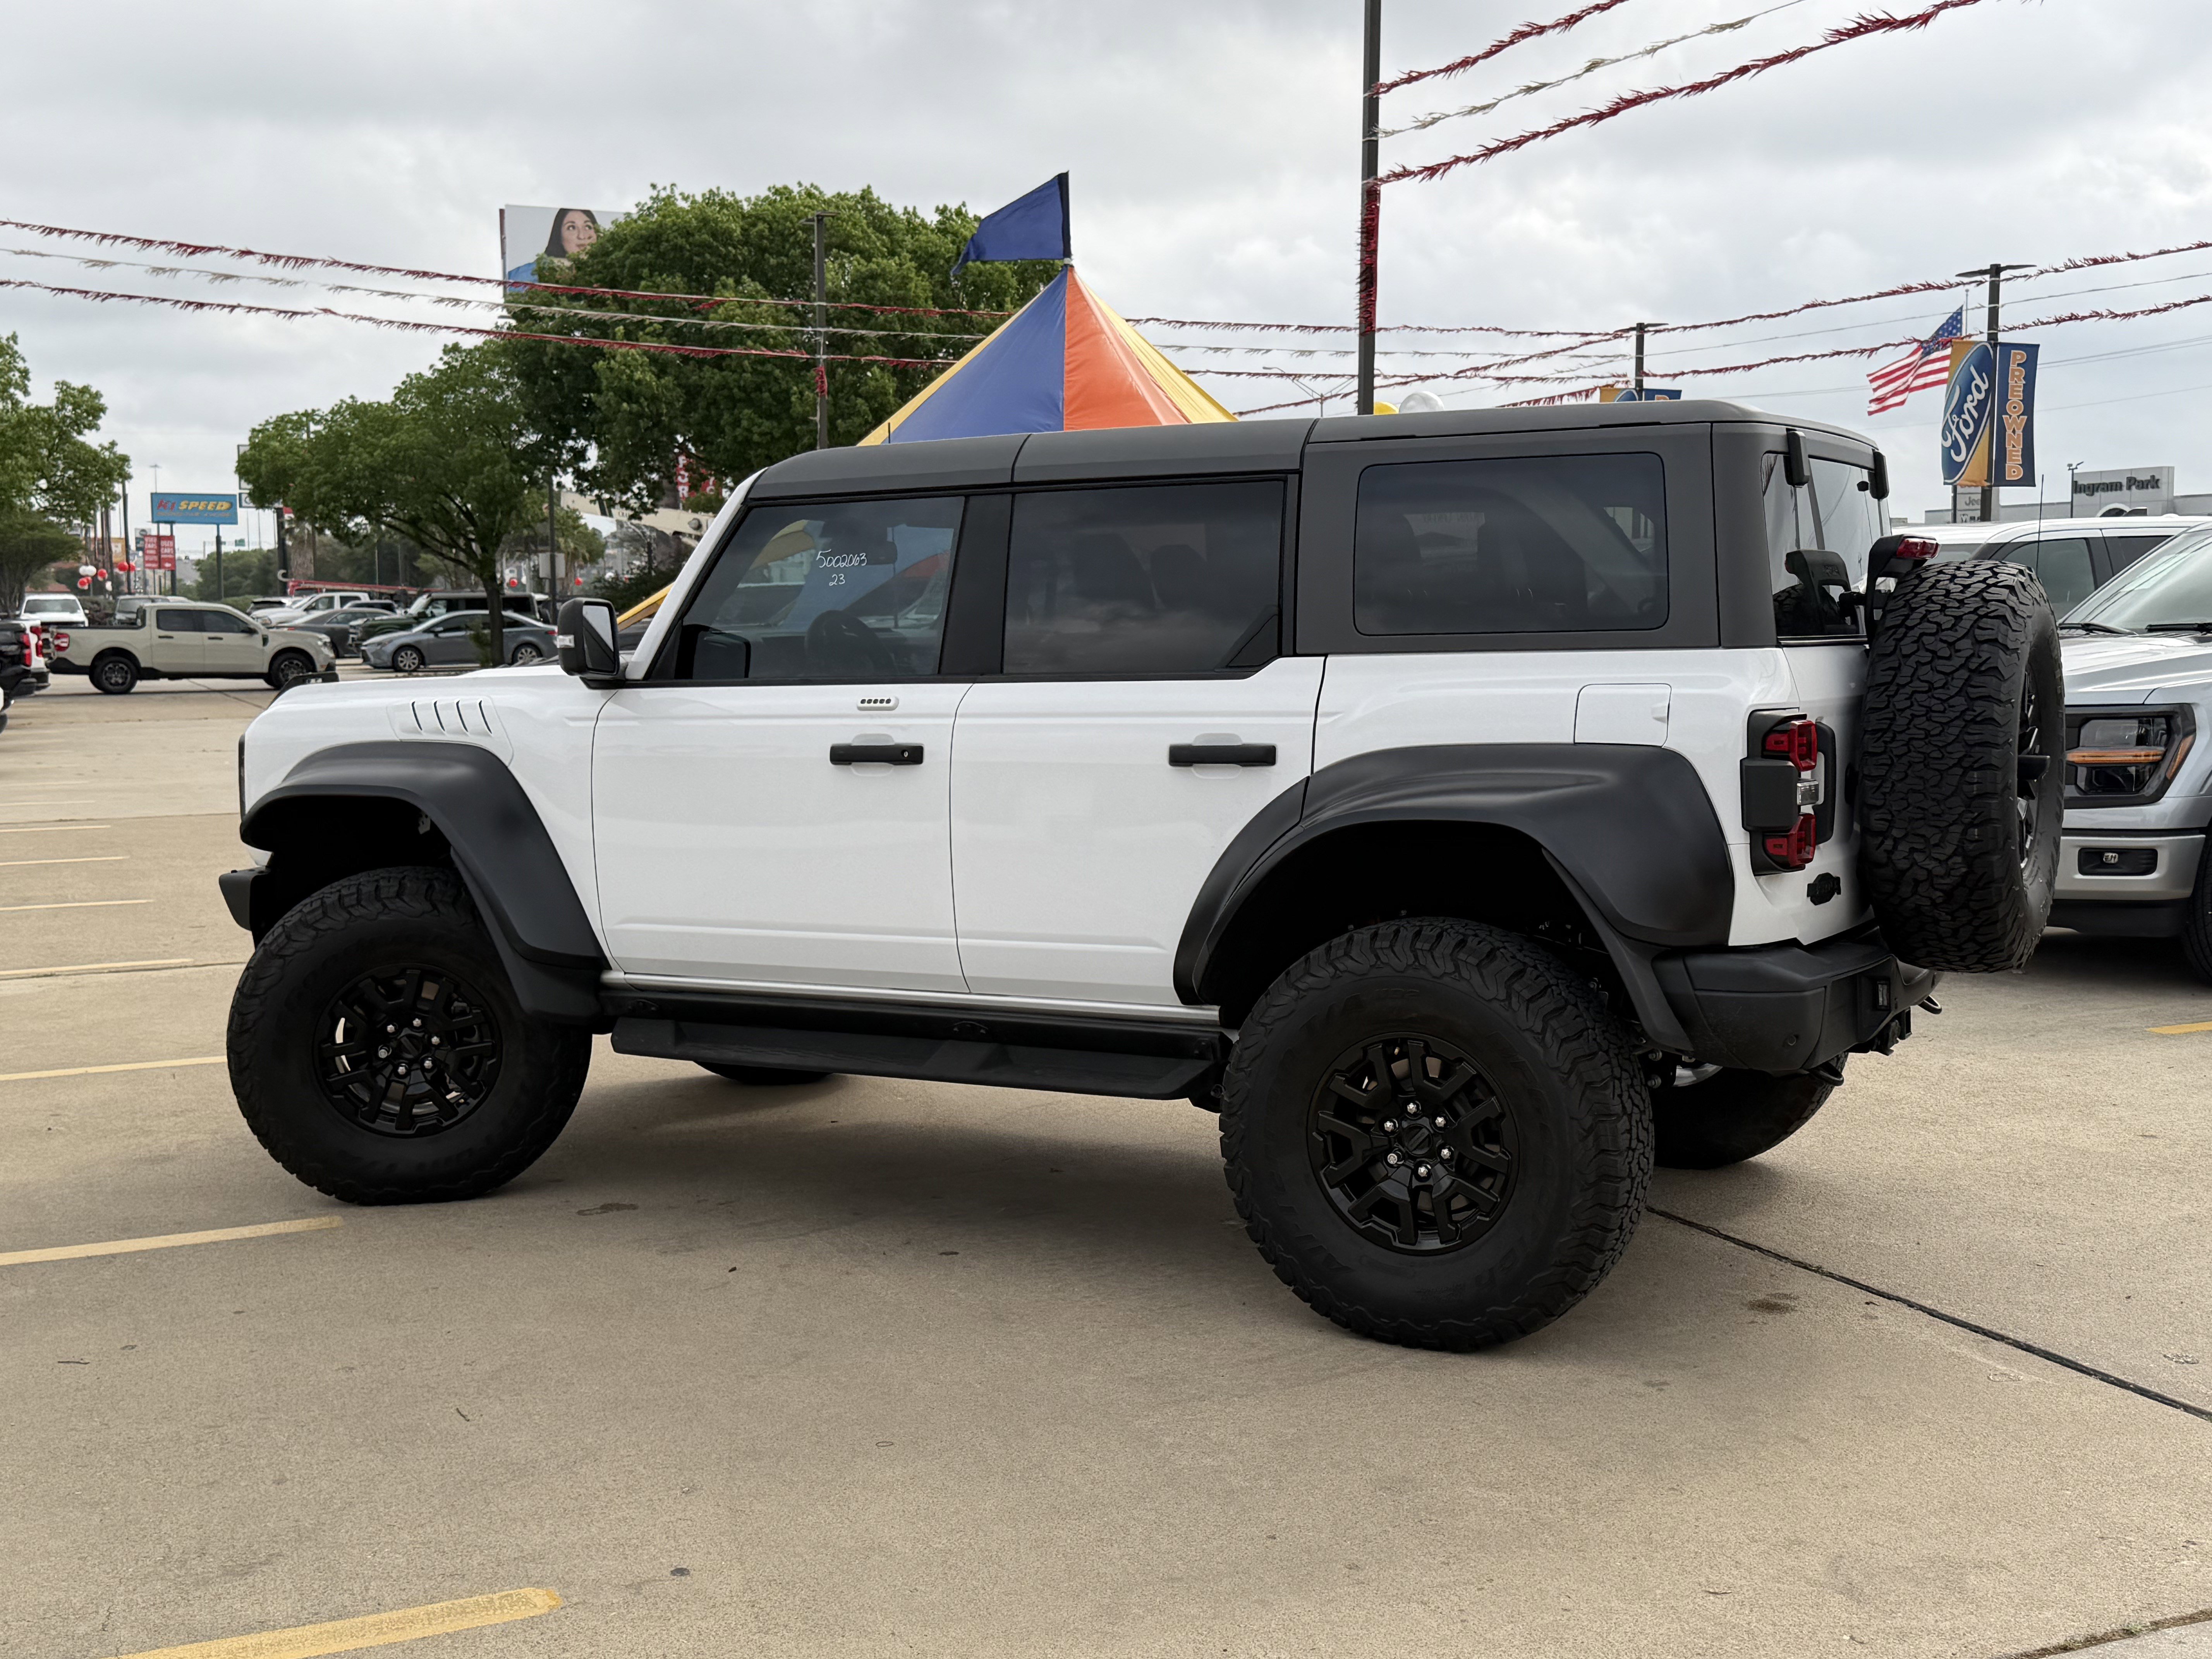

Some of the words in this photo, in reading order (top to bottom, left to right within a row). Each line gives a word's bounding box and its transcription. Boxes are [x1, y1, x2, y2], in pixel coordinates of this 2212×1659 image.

[1941, 364, 1989, 462] Ford
[2002, 350, 2027, 480] PREOWNED
[2073, 480, 2123, 496] Ingram
[2126, 475, 2160, 490] Park
[179, 500, 232, 511] SPEED
[1965, 496, 1981, 506] Jee
[816, 549, 867, 568] 5002063
[829, 574, 846, 586] 23
